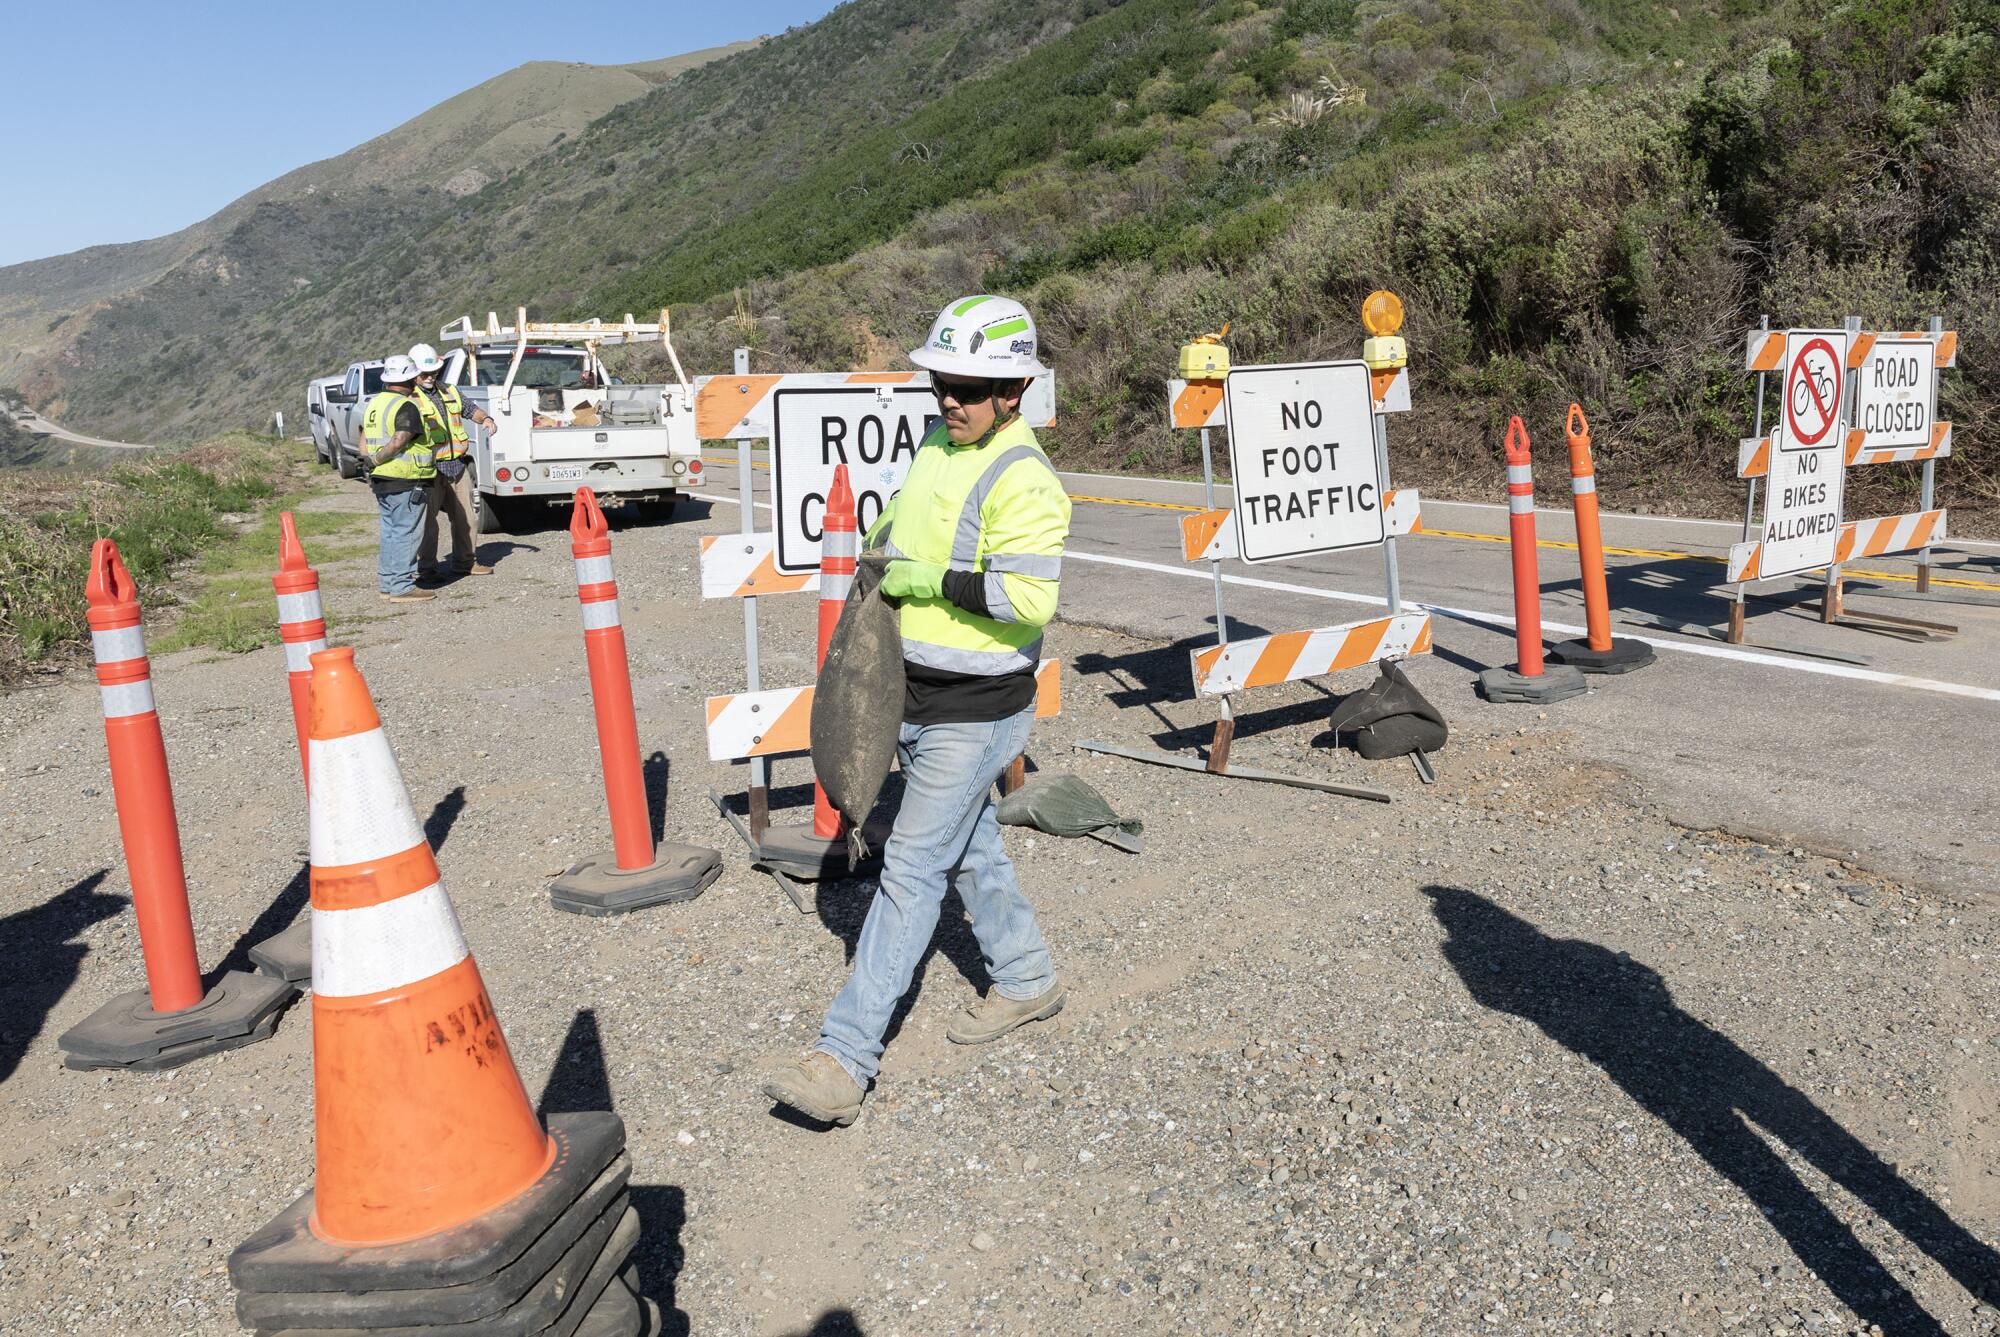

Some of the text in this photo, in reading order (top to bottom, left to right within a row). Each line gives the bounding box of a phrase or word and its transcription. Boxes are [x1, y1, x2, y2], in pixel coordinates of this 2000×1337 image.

[932, 341, 958, 353] GRANITE
[1874, 357, 1919, 388] ROAD
[1280, 399, 1323, 431] NO
[1865, 402, 1925, 434] CLOSED
[821, 414, 939, 465] ROA
[1262, 442, 1340, 478] FOOT
[1797, 453, 1818, 476] NO
[1244, 483, 1375, 525] TRAFFIC
[1783, 482, 1827, 509] BIKES
[1766, 512, 1836, 544] ALLOWED
